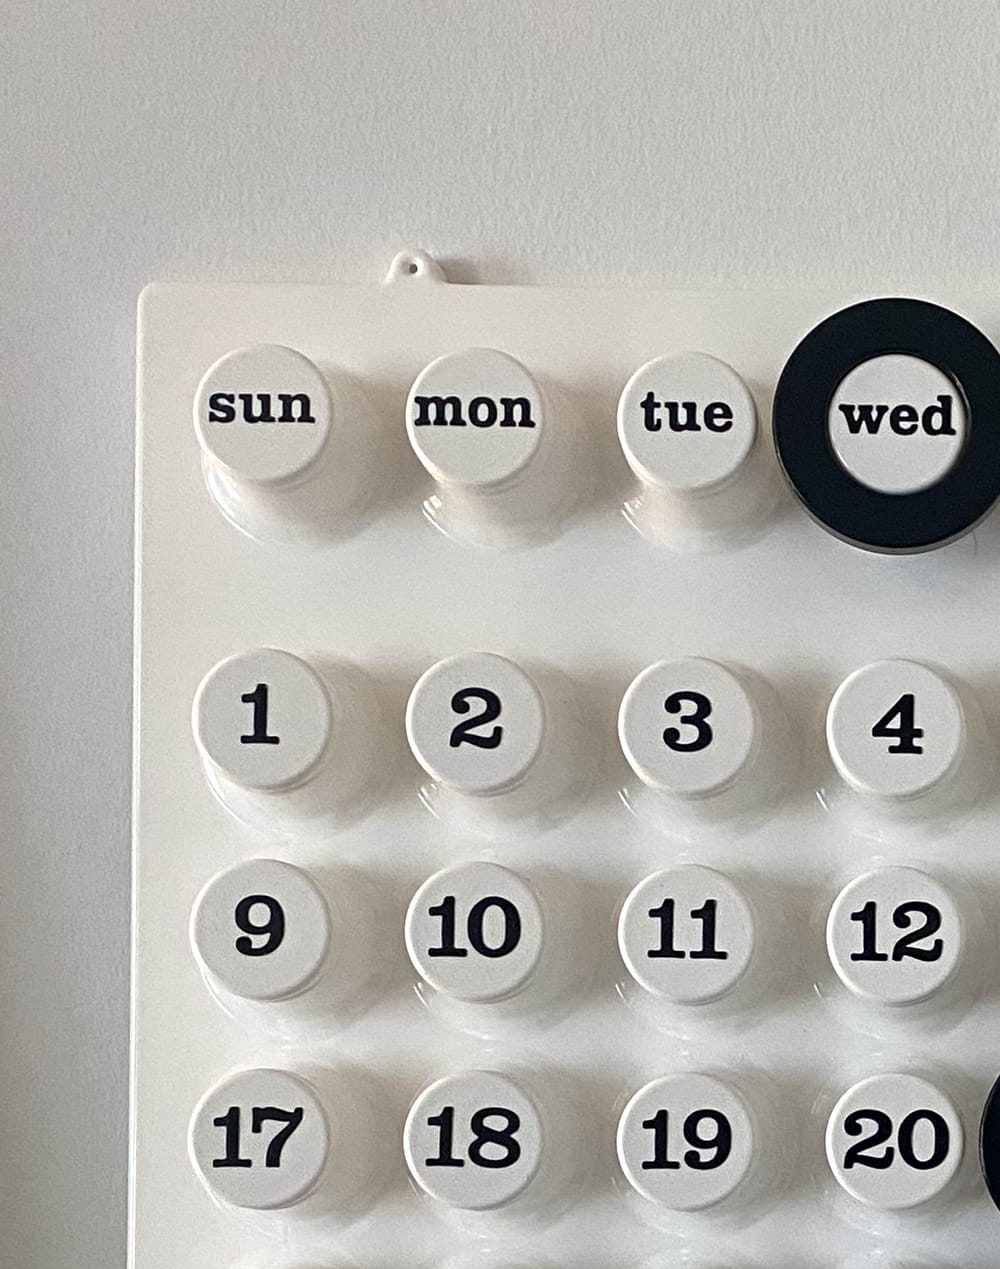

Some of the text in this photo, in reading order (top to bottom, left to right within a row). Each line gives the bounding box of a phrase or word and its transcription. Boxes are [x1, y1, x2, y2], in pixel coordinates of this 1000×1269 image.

[208, 392, 316, 424] sun
[414, 395, 536, 429] mon
[639, 391, 734, 433] tue
[838, 394, 957, 437] wed
[240, 683, 280, 745] 1
[449, 687, 503, 750] 2
[662, 690, 713, 753] 3
[871, 693, 924, 755] 4
[234, 894, 286, 957] 9
[427, 895, 522, 959] 10
[647, 898, 729, 960] 11
[850, 901, 944, 963] 12
[212, 1106, 304, 1169] 17
[425, 1106, 521, 1169] 18
[641, 1108, 733, 1171] 19
[843, 1108, 950, 1171] 20
